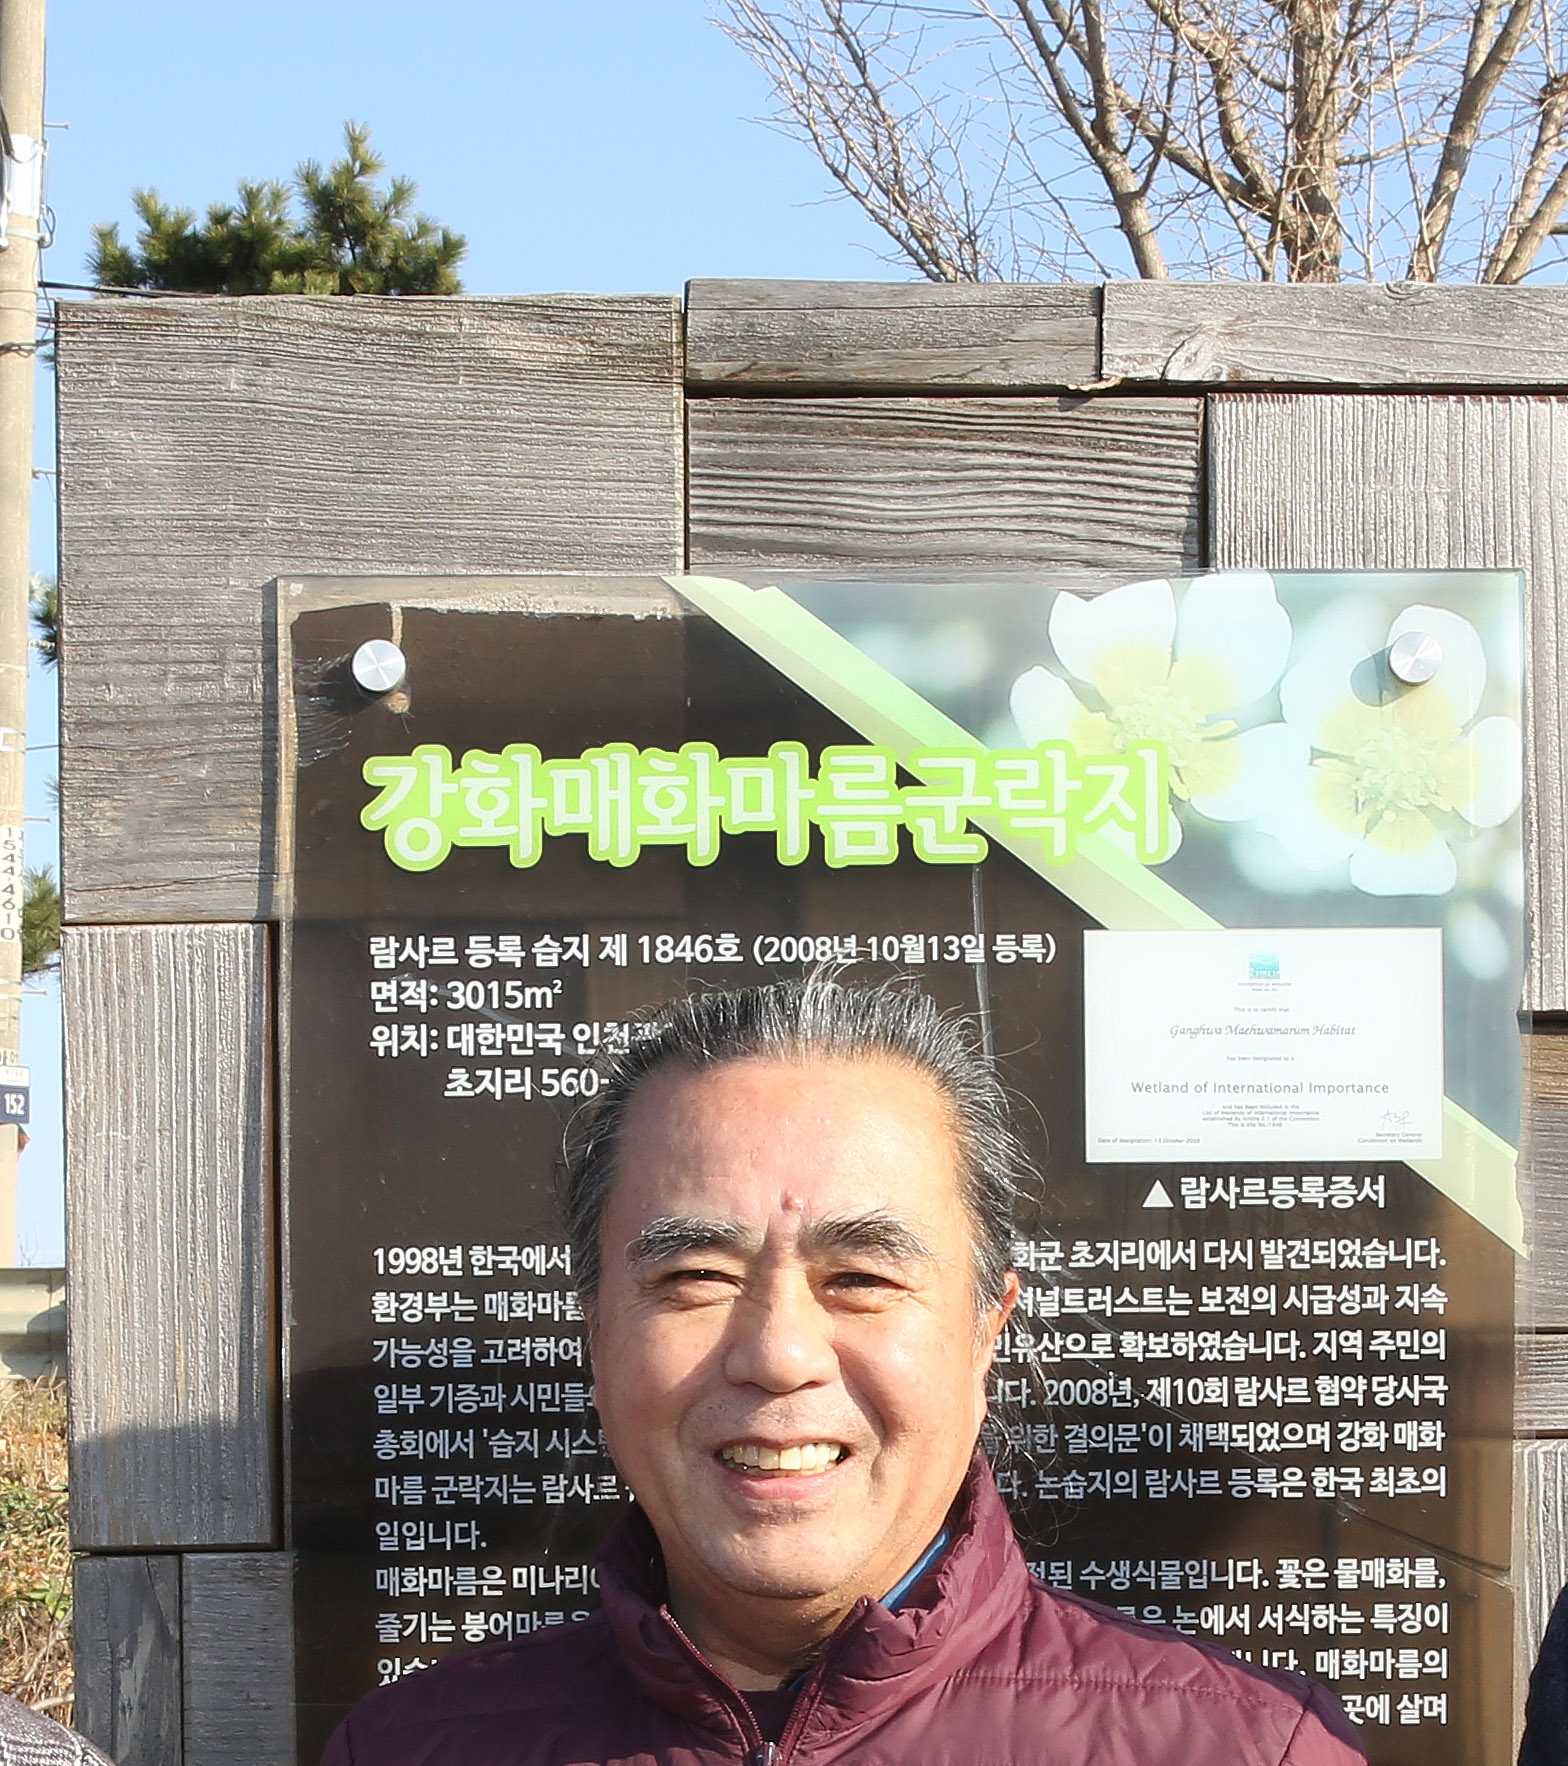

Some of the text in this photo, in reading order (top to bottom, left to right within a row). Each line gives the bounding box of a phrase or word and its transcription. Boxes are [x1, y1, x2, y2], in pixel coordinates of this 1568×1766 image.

[363, 741, 1174, 871] 강화매화마름군락지
[369, 932, 1056, 969] 람사르 등록 습지 제 1846호 (2008년 10월13일 등록)
[369, 980, 438, 1013] 면적:
[369, 1023, 438, 1057] 위치:
[446, 1022, 565, 1056] 대한민국
[1312, 1024, 1357, 1036] Habitat
[444, 1066, 532, 1100] 초지리
[1131, 1081, 1389, 1096] Wetland of International Importance
[4, 1093, 25, 1115] 152
[1180, 1175, 1385, 1208] 람사르등록증서
[373, 1245, 463, 1276] 1998년
[469, 1244, 571, 1276] 한국에서
[1069, 1239, 1196, 1271] 초지리에서
[1203, 1239, 1252, 1270] 다시
[1260, 1238, 1446, 1270] 발견되었습니다.
[371, 1291, 478, 1323] 환경부는
[1198, 1285, 1276, 1316] 보전의
[1283, 1284, 1388, 1315] 시급성과
[1395, 1283, 1448, 1314] 지속
[372, 1337, 476, 1368] 가능성을
[481, 1336, 583, 1367] 고려하여
[1119, 1331, 1306, 1363] 확보하였습니다.
[1312, 1330, 1363, 1361] 지역
[1369, 1329, 1446, 1361] 주민의
[374, 1384, 424, 1415] 일부
[430, 1383, 506, 1414] 기증과
[1044, 1376, 1140, 1408] 2008년,
[1146, 1377, 1229, 1410] 제10회
[1233, 1377, 1311, 1408] 람사르
[1314, 1375, 1366, 1408] 협약
[1371, 1375, 1448, 1408] 당사국
[373, 1429, 474, 1460] 총회에서
[483, 1428, 538, 1459] '습지
[1064, 1422, 1172, 1453] 결의문'이
[1179, 1421, 1329, 1453] 채택되었으며
[1336, 1421, 1387, 1452] 강화
[1394, 1421, 1445, 1451] 매화
[375, 1475, 426, 1505] 마름
[432, 1474, 536, 1504] 군락지는
[542, 1474, 620, 1504] 람사르
[1035, 1469, 1137, 1499] 논습지의
[1145, 1468, 1222, 1499] 람사르
[1228, 1468, 1307, 1498] 등록은
[1311, 1467, 1363, 1498] 한국
[1369, 1466, 1446, 1498] 최초의
[376, 1521, 486, 1550] 일입니다.
[376, 1565, 506, 1597] 매화마름은
[512, 1565, 600, 1596] 미나리
[1079, 1559, 1270, 1590] 수생식물입니다.
[1276, 1558, 1329, 1590] 꽃은
[1333, 1558, 1446, 1590] 물매화를,
[376, 1612, 456, 1643] 줄기는
[1172, 1604, 1251, 1635] 논에서
[1257, 1603, 1364, 1635] 서식하는
[1370, 1602, 1448, 1634] 특징이
[1315, 1649, 1447, 1680] 매화마름의
[1396, 1693, 1447, 1724] 살며
